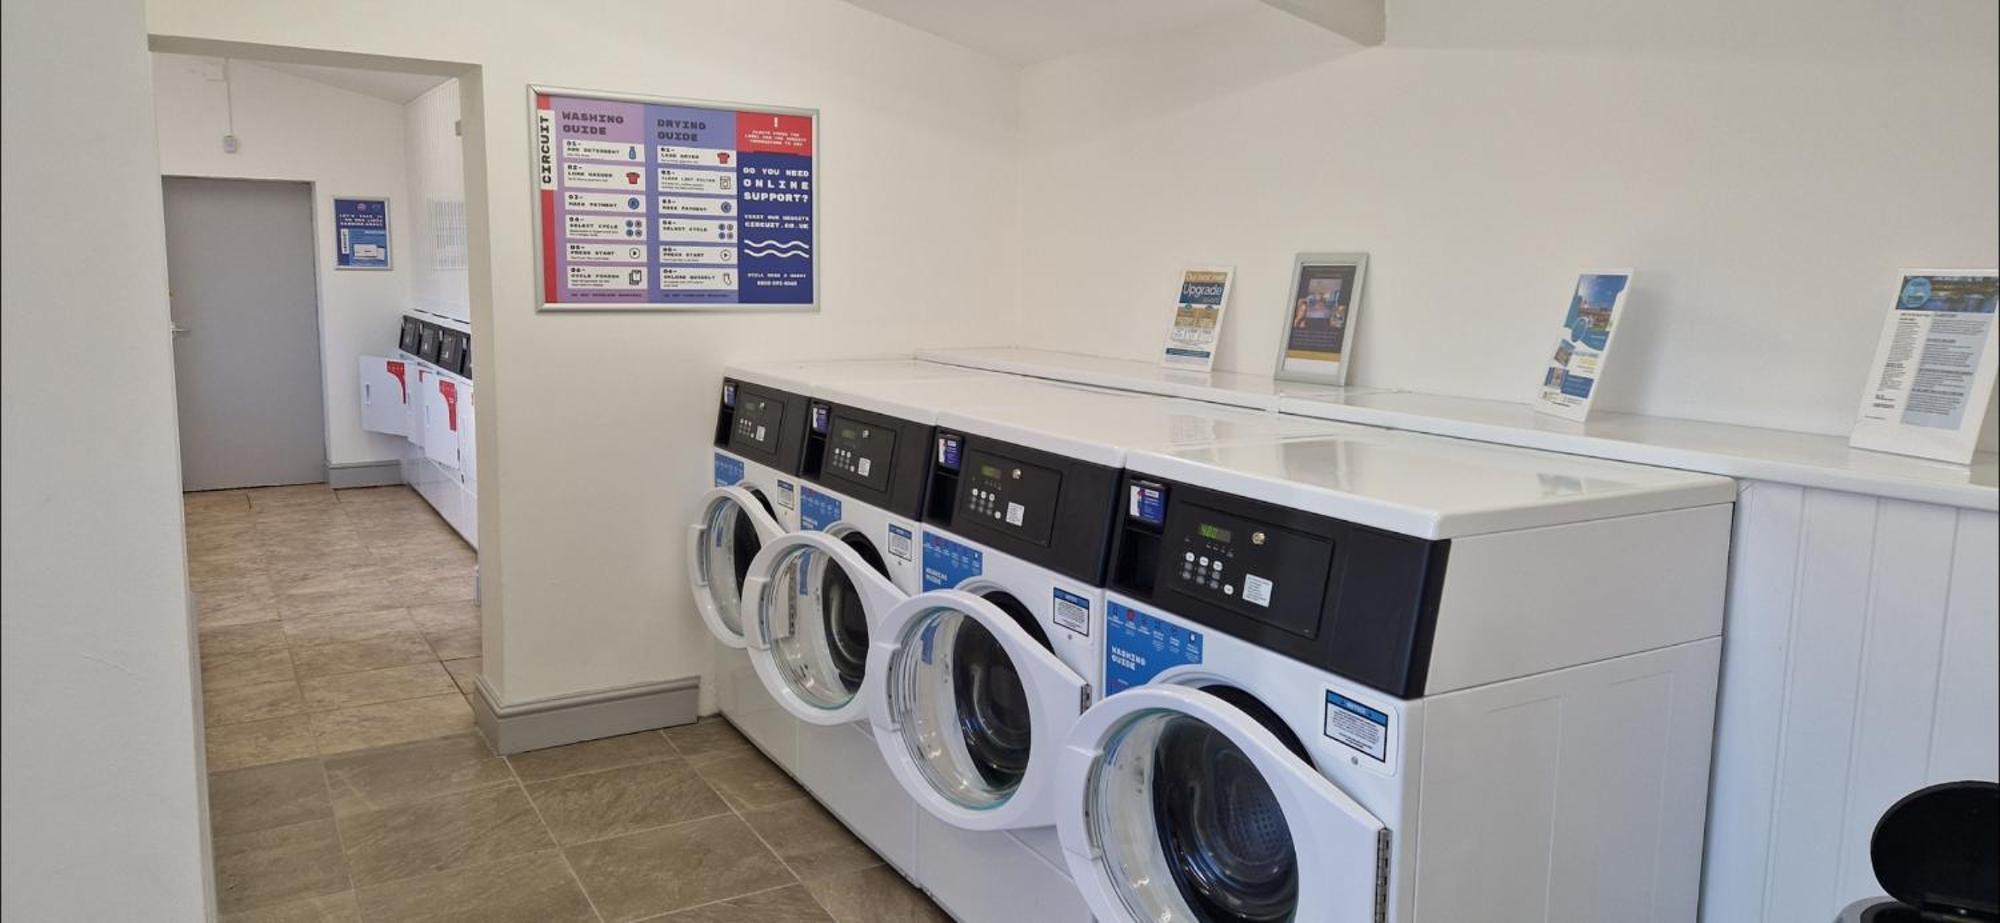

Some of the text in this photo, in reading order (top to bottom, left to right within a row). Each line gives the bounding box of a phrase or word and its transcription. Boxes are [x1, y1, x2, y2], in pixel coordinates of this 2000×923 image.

[562, 111, 624, 124] WASHING
[562, 124, 606, 135] GUIDE
[657, 119, 706, 130] DRYING
[657, 132, 698, 141] GUIDE
[540, 116, 552, 184] CIRCUIT
[743, 179, 809, 190] ONLINE
[744, 192, 808, 202] SUPPORT?
[1183, 283, 1222, 297] Upgrade
[1112, 645, 1146, 666] WASHING
[1111, 654, 1136, 671] GUIDE
